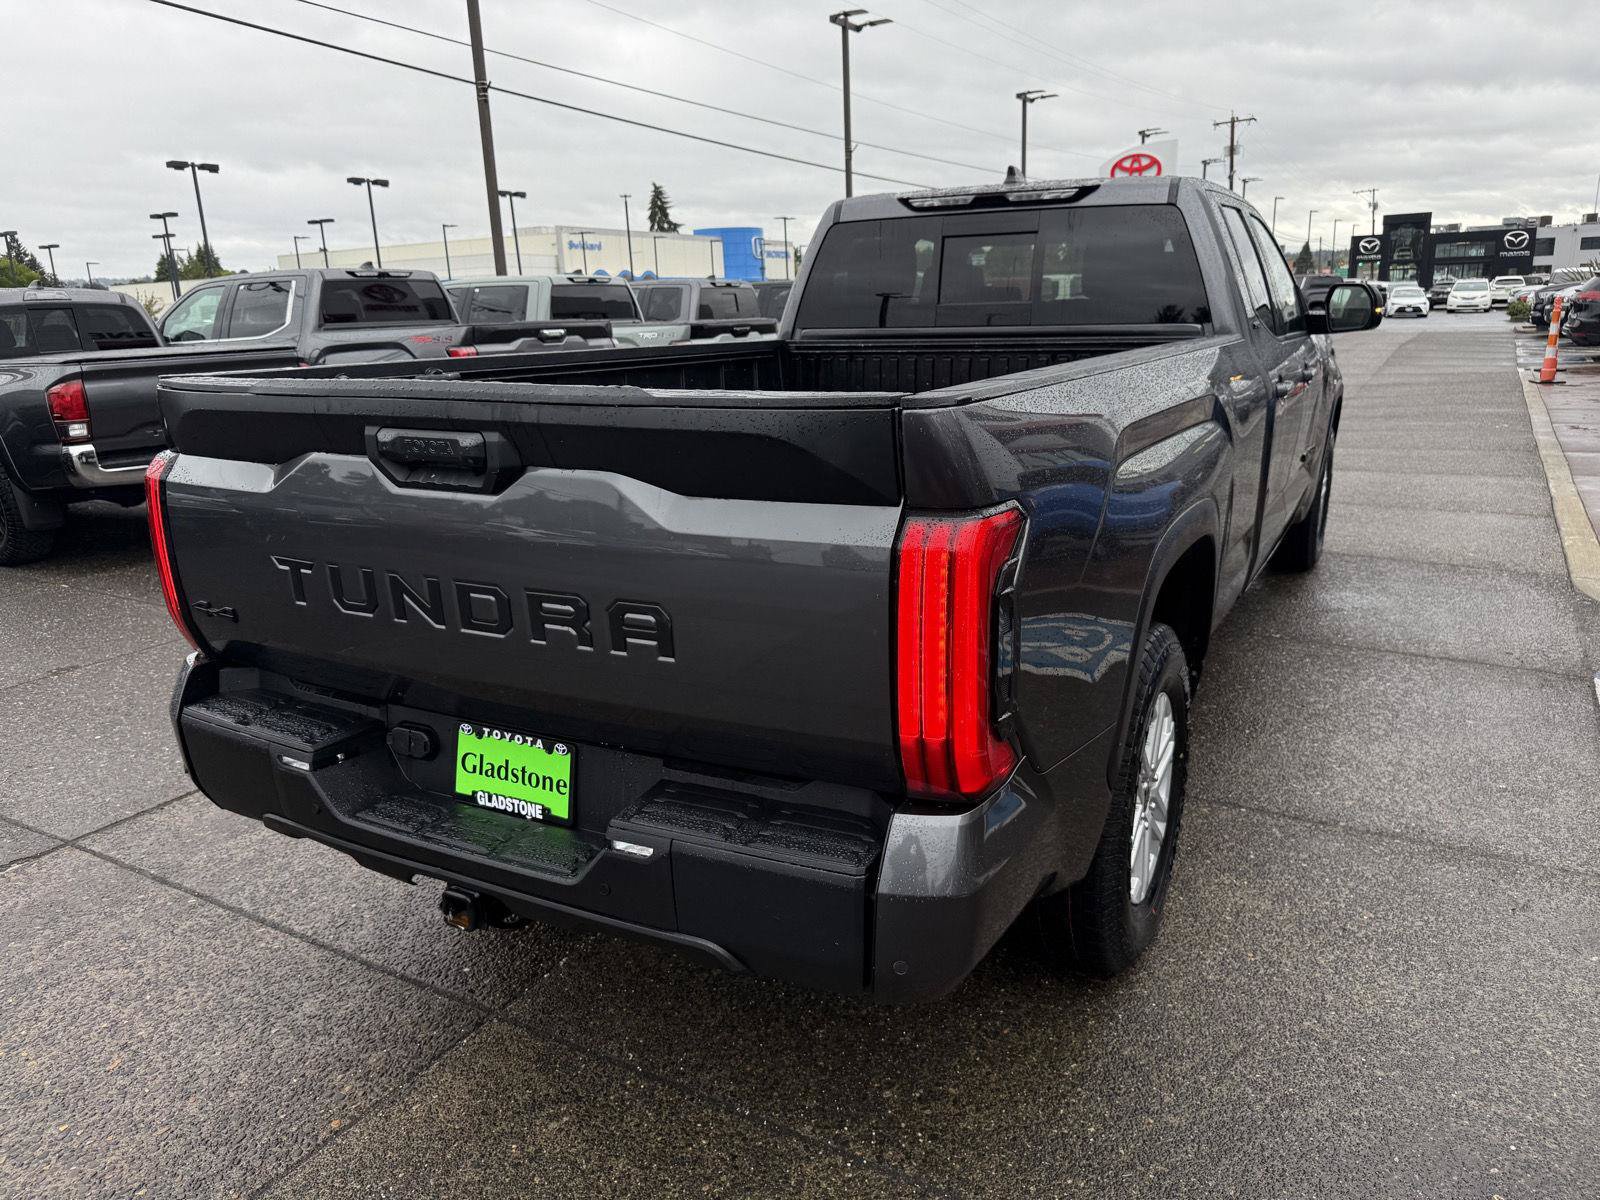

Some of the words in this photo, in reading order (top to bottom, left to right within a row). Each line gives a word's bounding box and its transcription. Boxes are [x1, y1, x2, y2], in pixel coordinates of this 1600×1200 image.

[403, 438, 454, 456] TOYOTA
[270, 555, 676, 663] TUNDRA
[482, 727, 544, 749] TOYOTA
[460, 752, 568, 796] Gladstone
[476, 790, 544, 820] GLADSTONE
